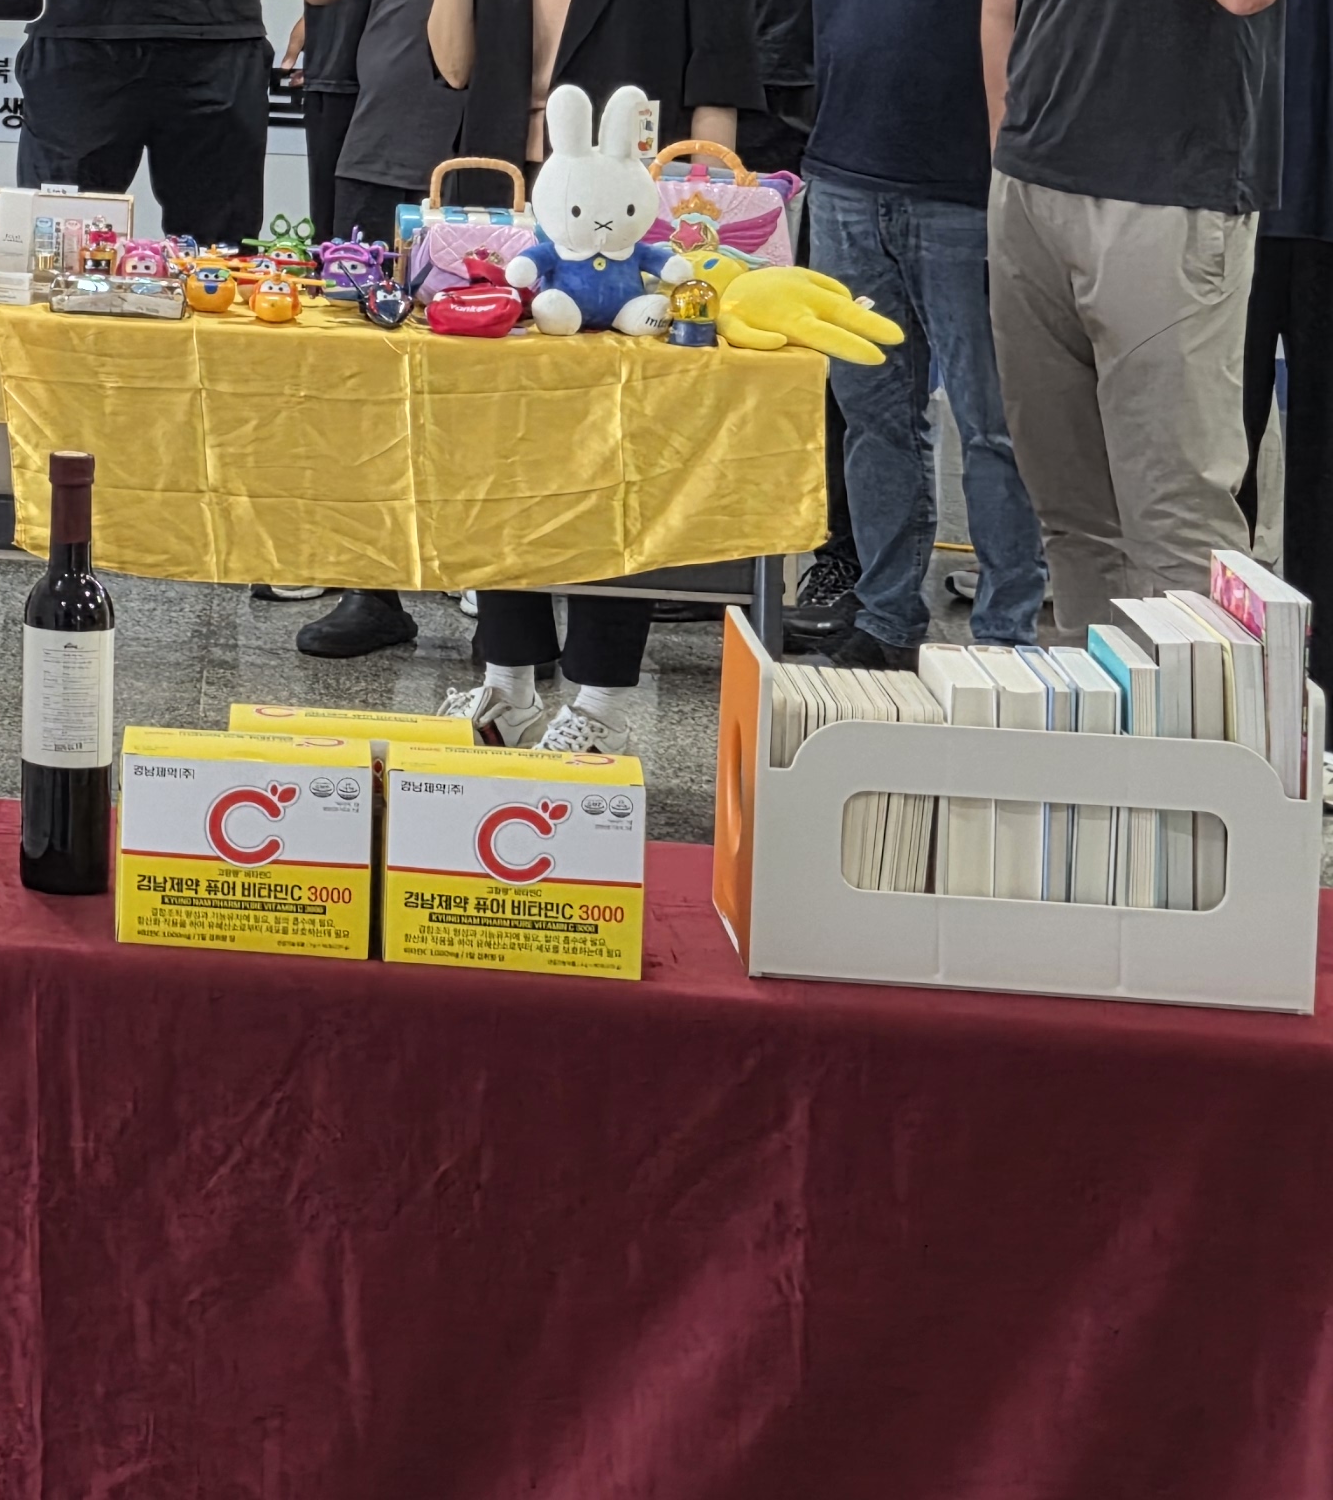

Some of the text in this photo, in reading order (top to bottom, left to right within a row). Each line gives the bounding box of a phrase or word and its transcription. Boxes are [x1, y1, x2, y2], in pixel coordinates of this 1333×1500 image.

[137, 874, 352, 904] 경남제약 퓨어 비타민C 3000
[403, 890, 625, 923] 경남제약 퓨어 비타민C 3000
